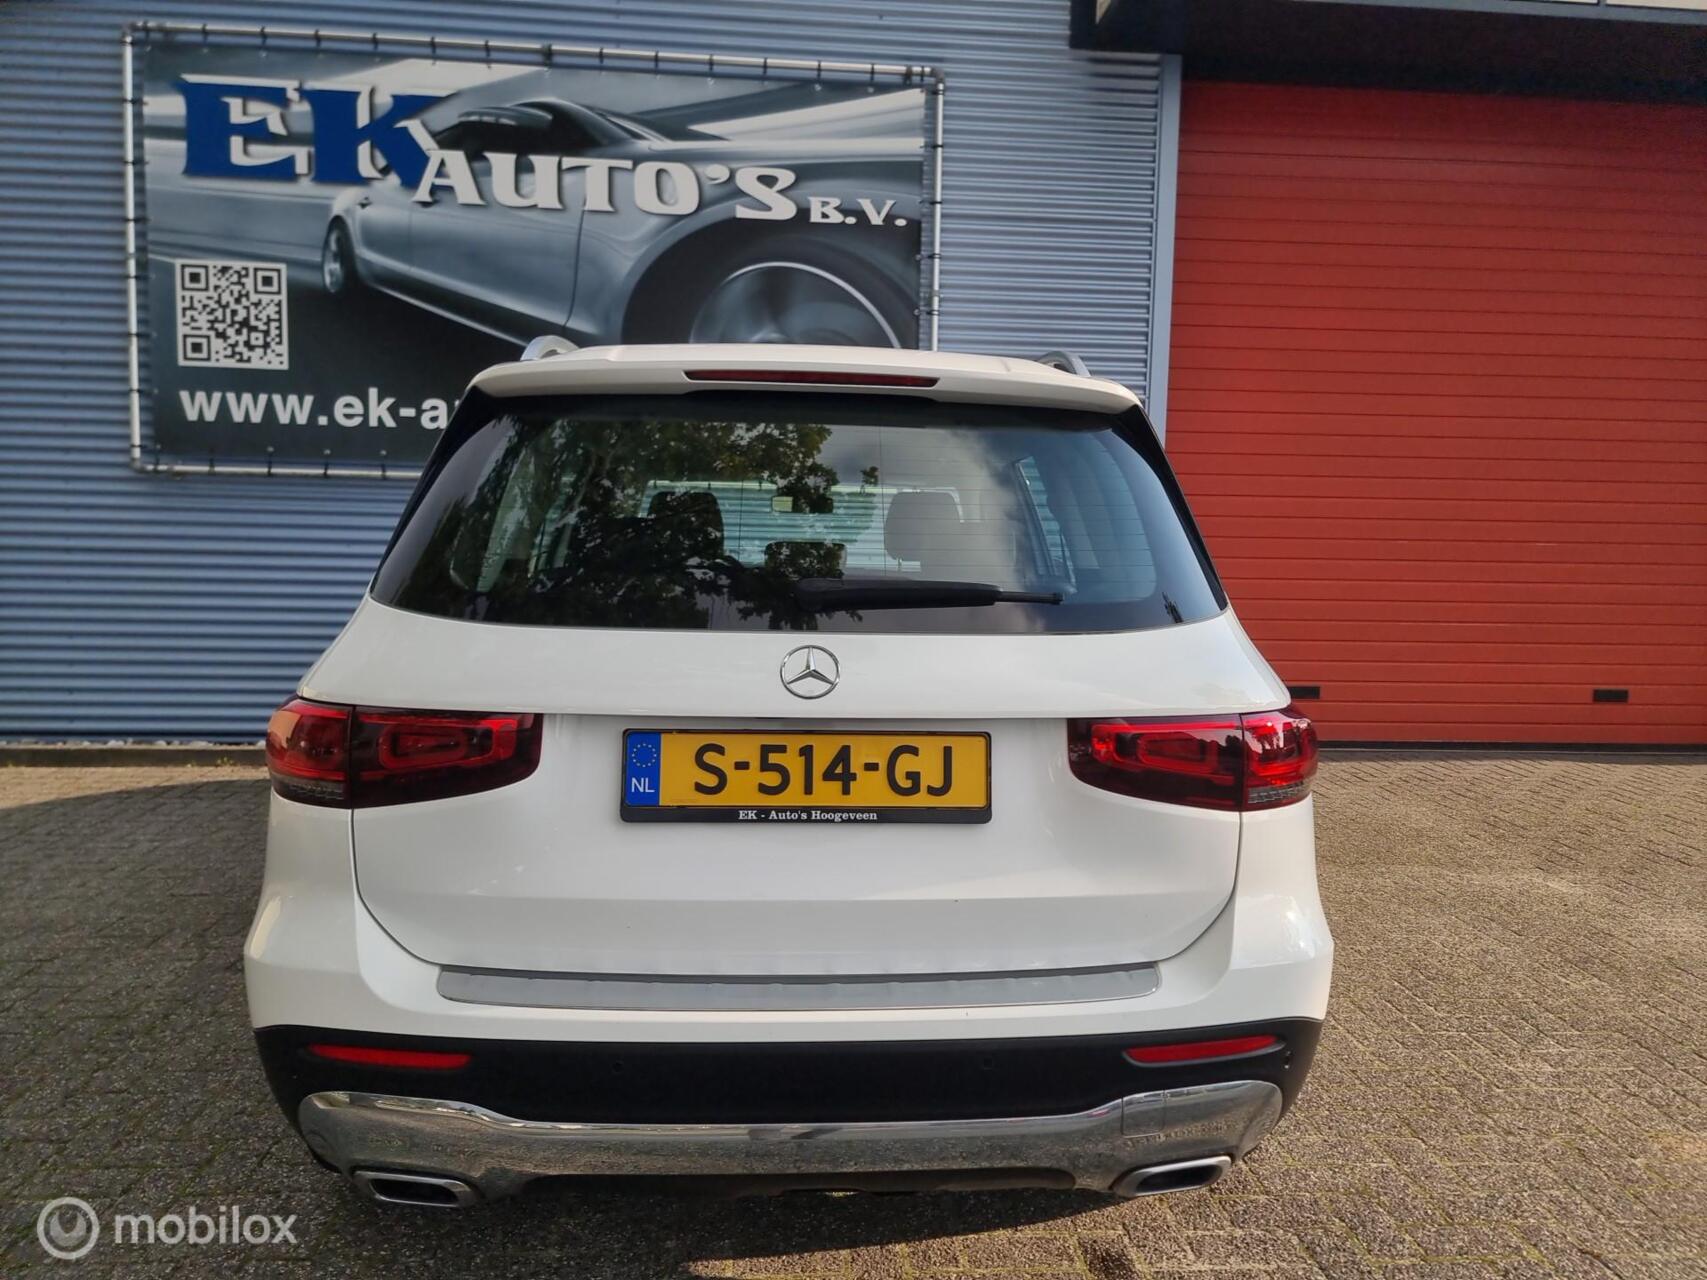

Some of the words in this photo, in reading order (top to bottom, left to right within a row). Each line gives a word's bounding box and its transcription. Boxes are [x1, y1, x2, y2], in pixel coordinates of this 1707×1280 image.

[180, 73, 460, 190] EK
[808, 197, 907, 227] B.V.
[179, 387, 460, 430] www.ek-a
[631, 777, 655, 793] NL
[694, 743, 953, 796] S-514-GJ
[738, 810, 757, 820] EK
[769, 810, 807, 820] Auto's
[811, 810, 878, 822] Hoogeveen
